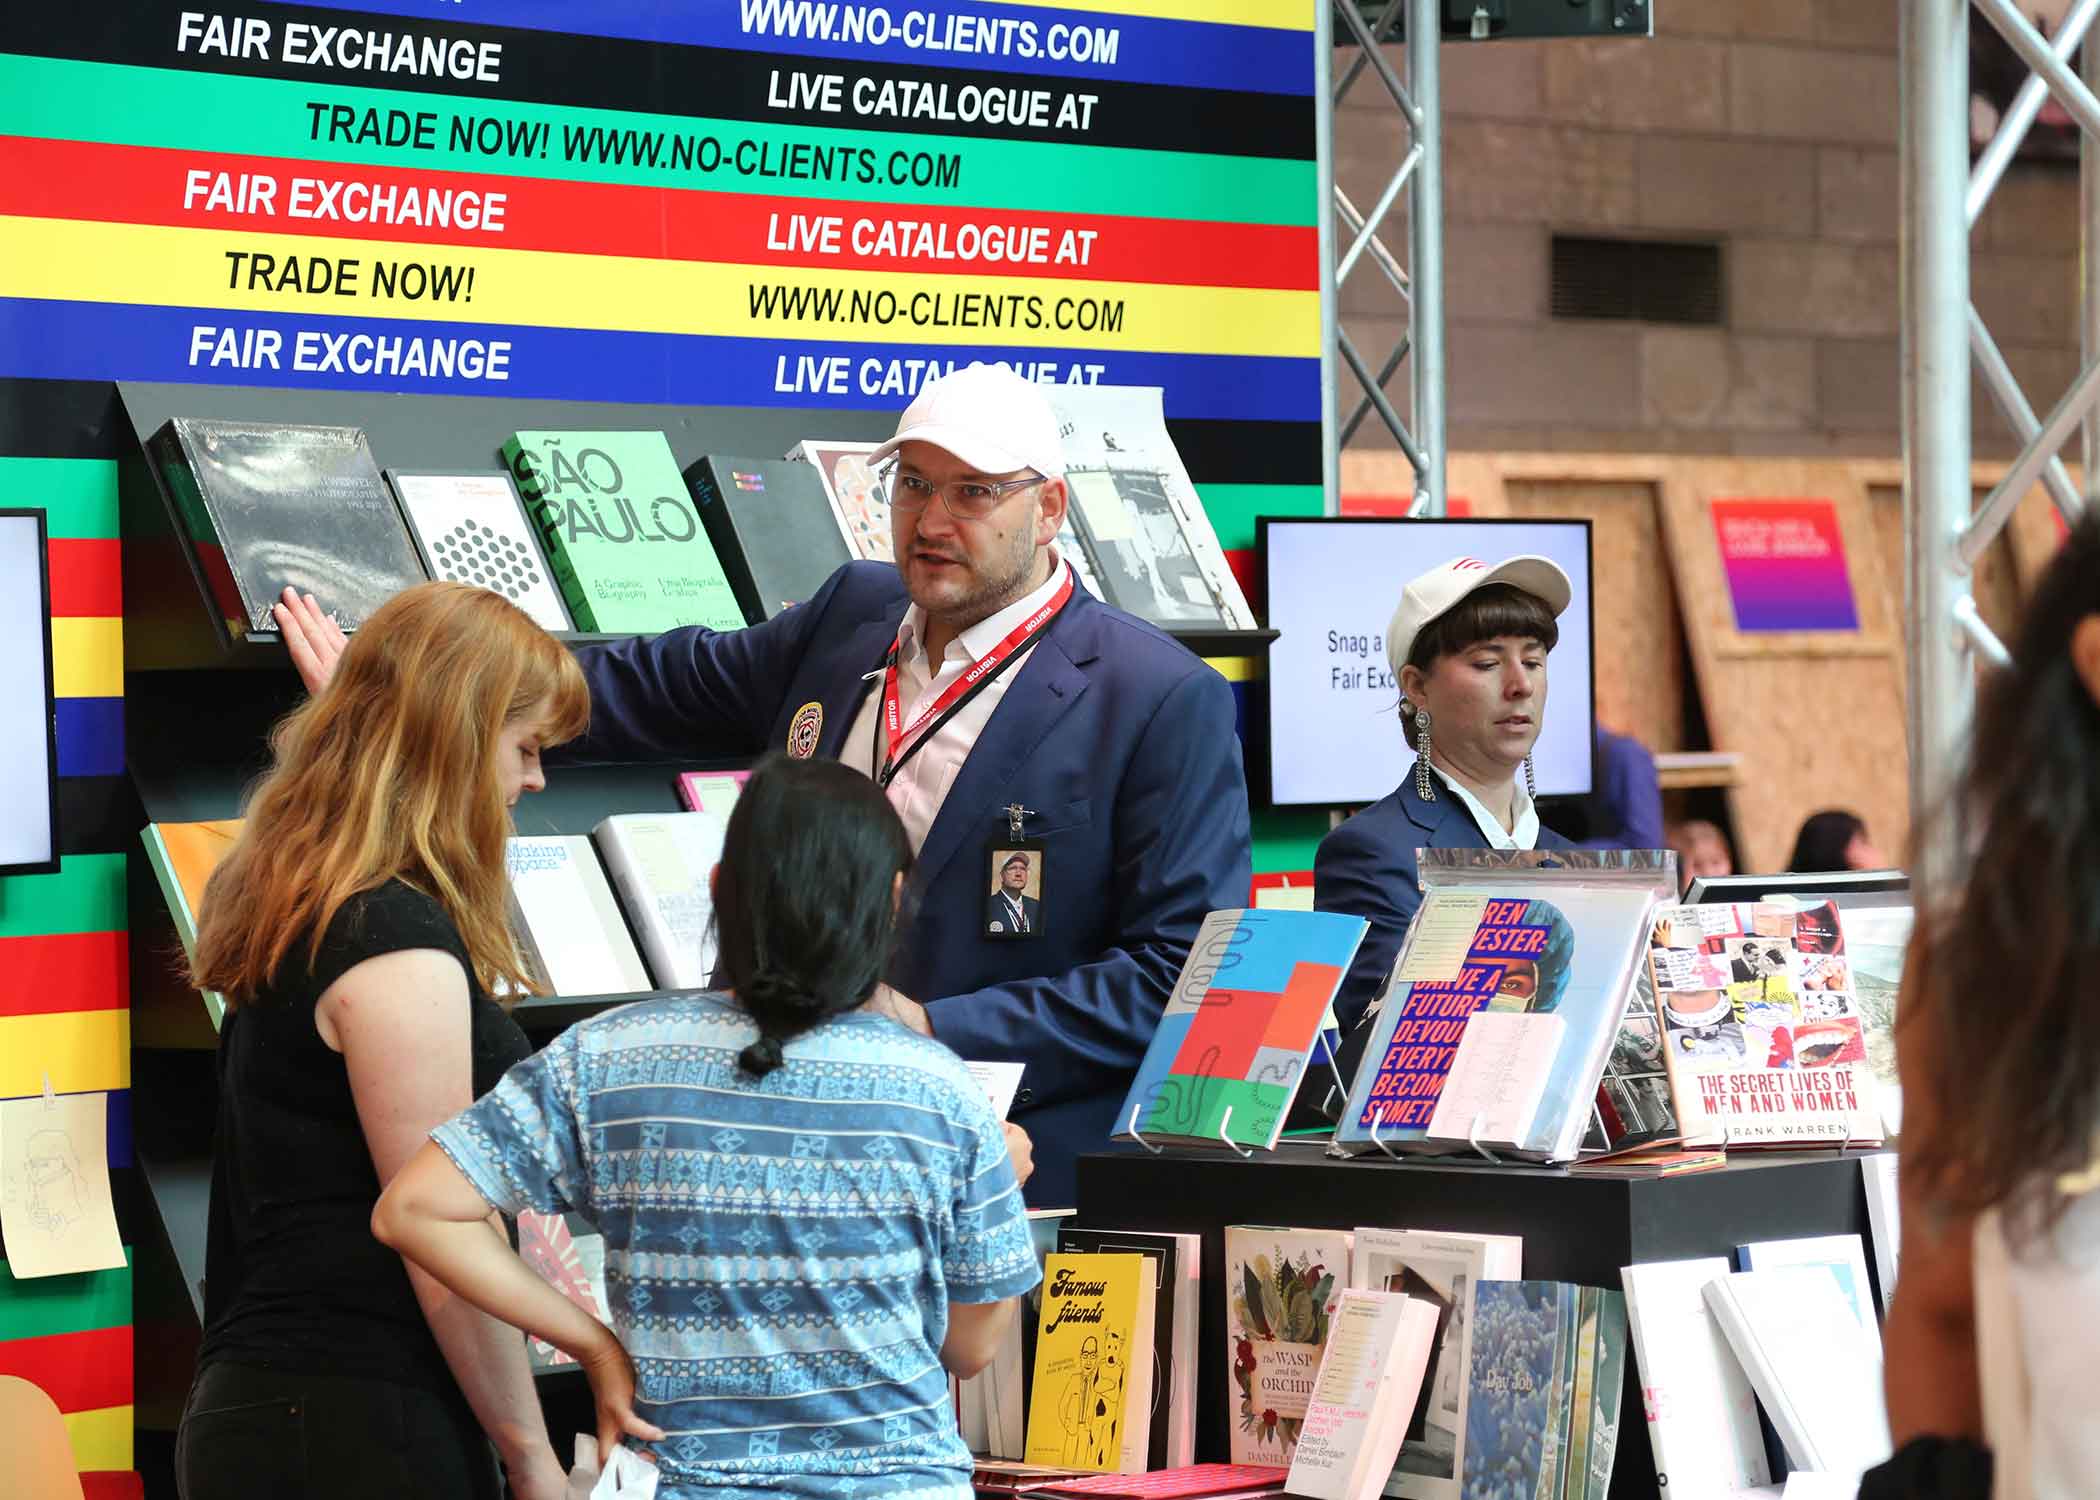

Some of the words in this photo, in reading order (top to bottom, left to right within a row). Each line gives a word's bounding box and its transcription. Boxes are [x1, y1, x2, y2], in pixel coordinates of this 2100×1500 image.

[177, 12, 271, 60] FAIR
[282, 22, 502, 82] EXCHANGE
[740, 0, 1119, 64] WWW.NO-CLIENTS.COM
[767, 70, 844, 112] LIVE
[852, 77, 1050, 127] CATALOGUE
[1055, 93, 1099, 130] AT
[306, 102, 438, 150] TRADE
[449, 115, 549, 159] NOW!
[563, 125, 961, 188] WWW.NO-CLIENTS.COM
[183, 169, 276, 216] FAIR
[288, 178, 507, 232] EXCHANGE
[767, 213, 843, 254] LIVE
[851, 218, 1049, 264] CATALOGUE
[1054, 229, 1098, 266] AT
[225, 251, 360, 296] TRADE
[371, 261, 475, 303] NOW!
[749, 284, 1124, 332] WWW.NO-CLIENTS.COM
[189, 326, 282, 370] FAIR
[293, 331, 512, 380] EXCHANGE
[774, 355, 850, 394] LIVE
[859, 357, 1058, 395] CATAUE
[514, 438, 623, 501] SÃO
[533, 496, 696, 553] PAULO
[1024, 606, 1053, 633] VISITOR
[1327, 629, 1368, 658] Snag
[1373, 635, 1382, 652] a
[966, 655, 997, 684] VISITOR
[1332, 666, 1362, 689] Fair
[889, 699, 898, 731] VISITOR
[1480, 968, 1503, 992] A
[1402, 993, 1489, 1018] FUTURE
[1391, 1020, 1467, 1044] DEVOU
[1697, 1074, 1725, 1095] THE
[1730, 1072, 1785, 1094] SECRET
[1789, 1072, 1831, 1092] LIVES
[1836, 1070, 1854, 1091] OF
[1750, 1093, 1786, 1113] AND
[1791, 1091, 1858, 1112] WOMEN
[1730, 1125, 1775, 1138] RANK
[1783, 1123, 1848, 1136] WARREN
[1050, 1268, 1108, 1298] Famous
[1045, 1300, 1105, 1335] friends
